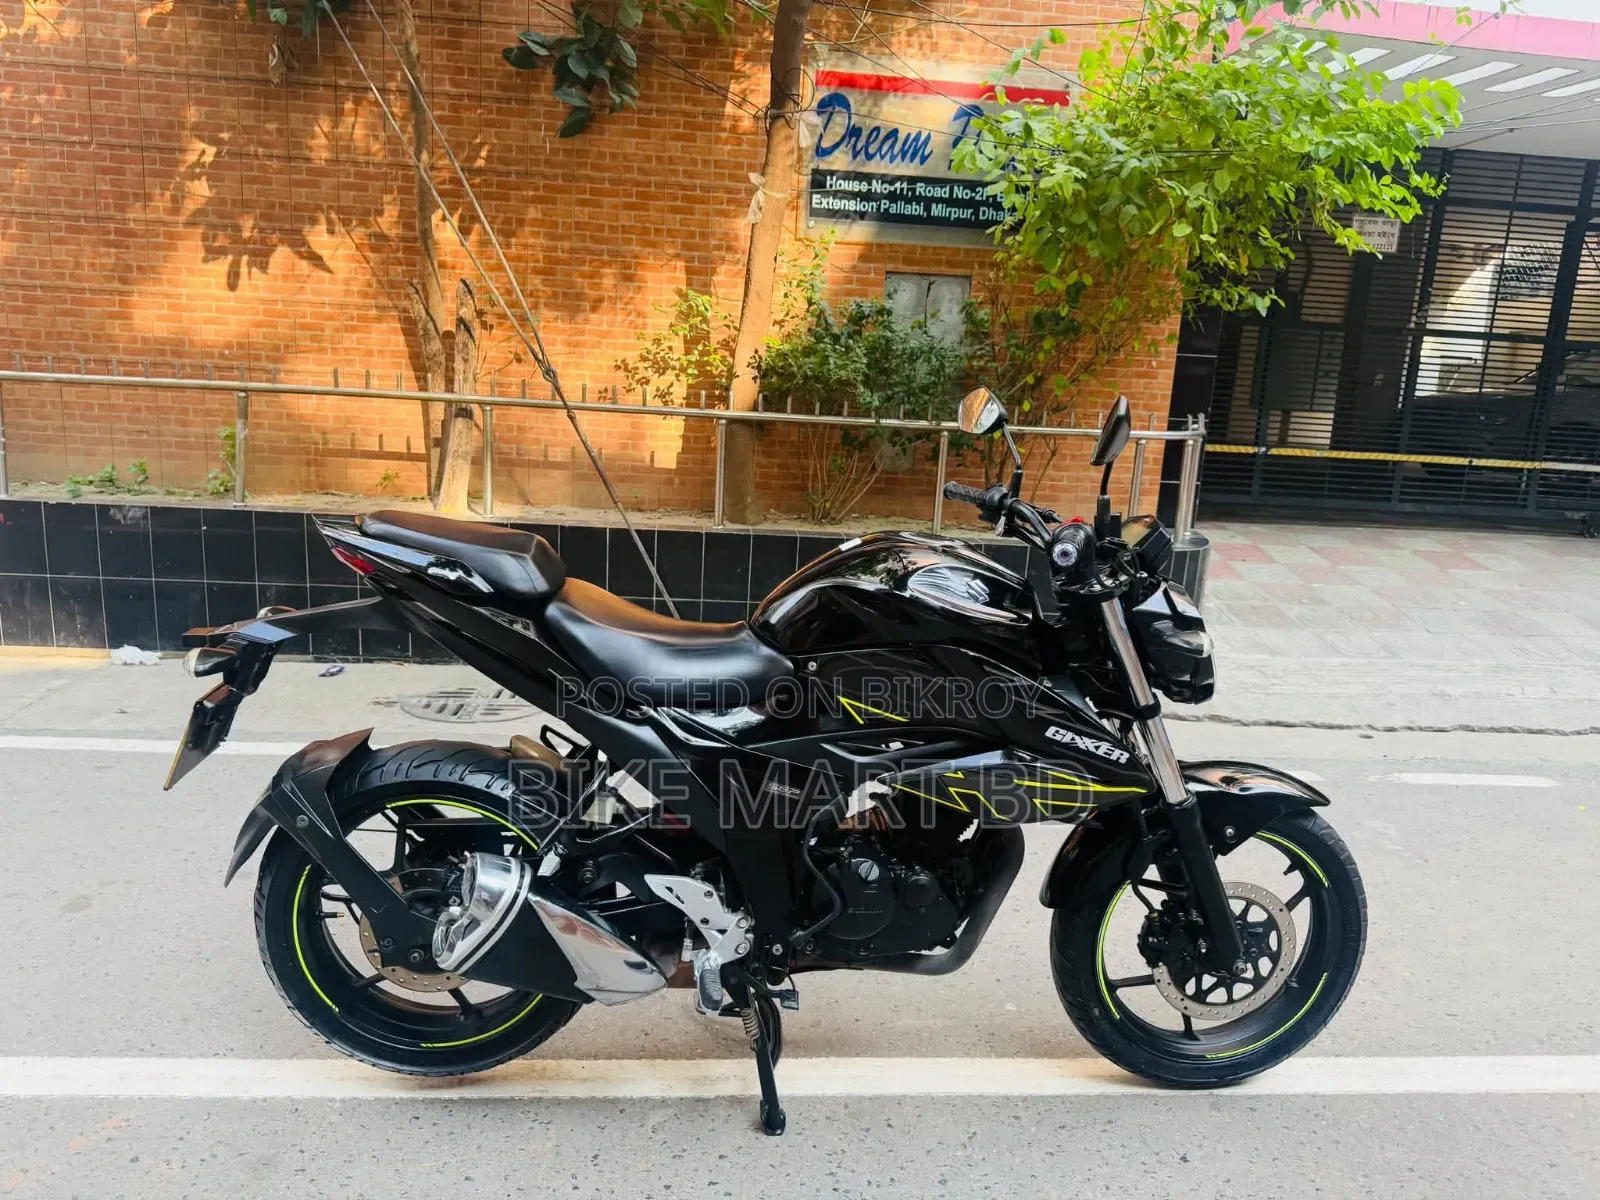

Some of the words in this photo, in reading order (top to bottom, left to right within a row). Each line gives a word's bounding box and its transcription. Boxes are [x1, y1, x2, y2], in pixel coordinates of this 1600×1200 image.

[815, 92, 933, 166] Dream
[826, 176, 868, 192] House
[871, 179, 911, 197] No-11,
[915, 183, 949, 198] Road
[880, 199, 927, 218] Pallabi,
[931, 203, 975, 221] Mirpur,
[1044, 725, 1131, 765] GIXXER
